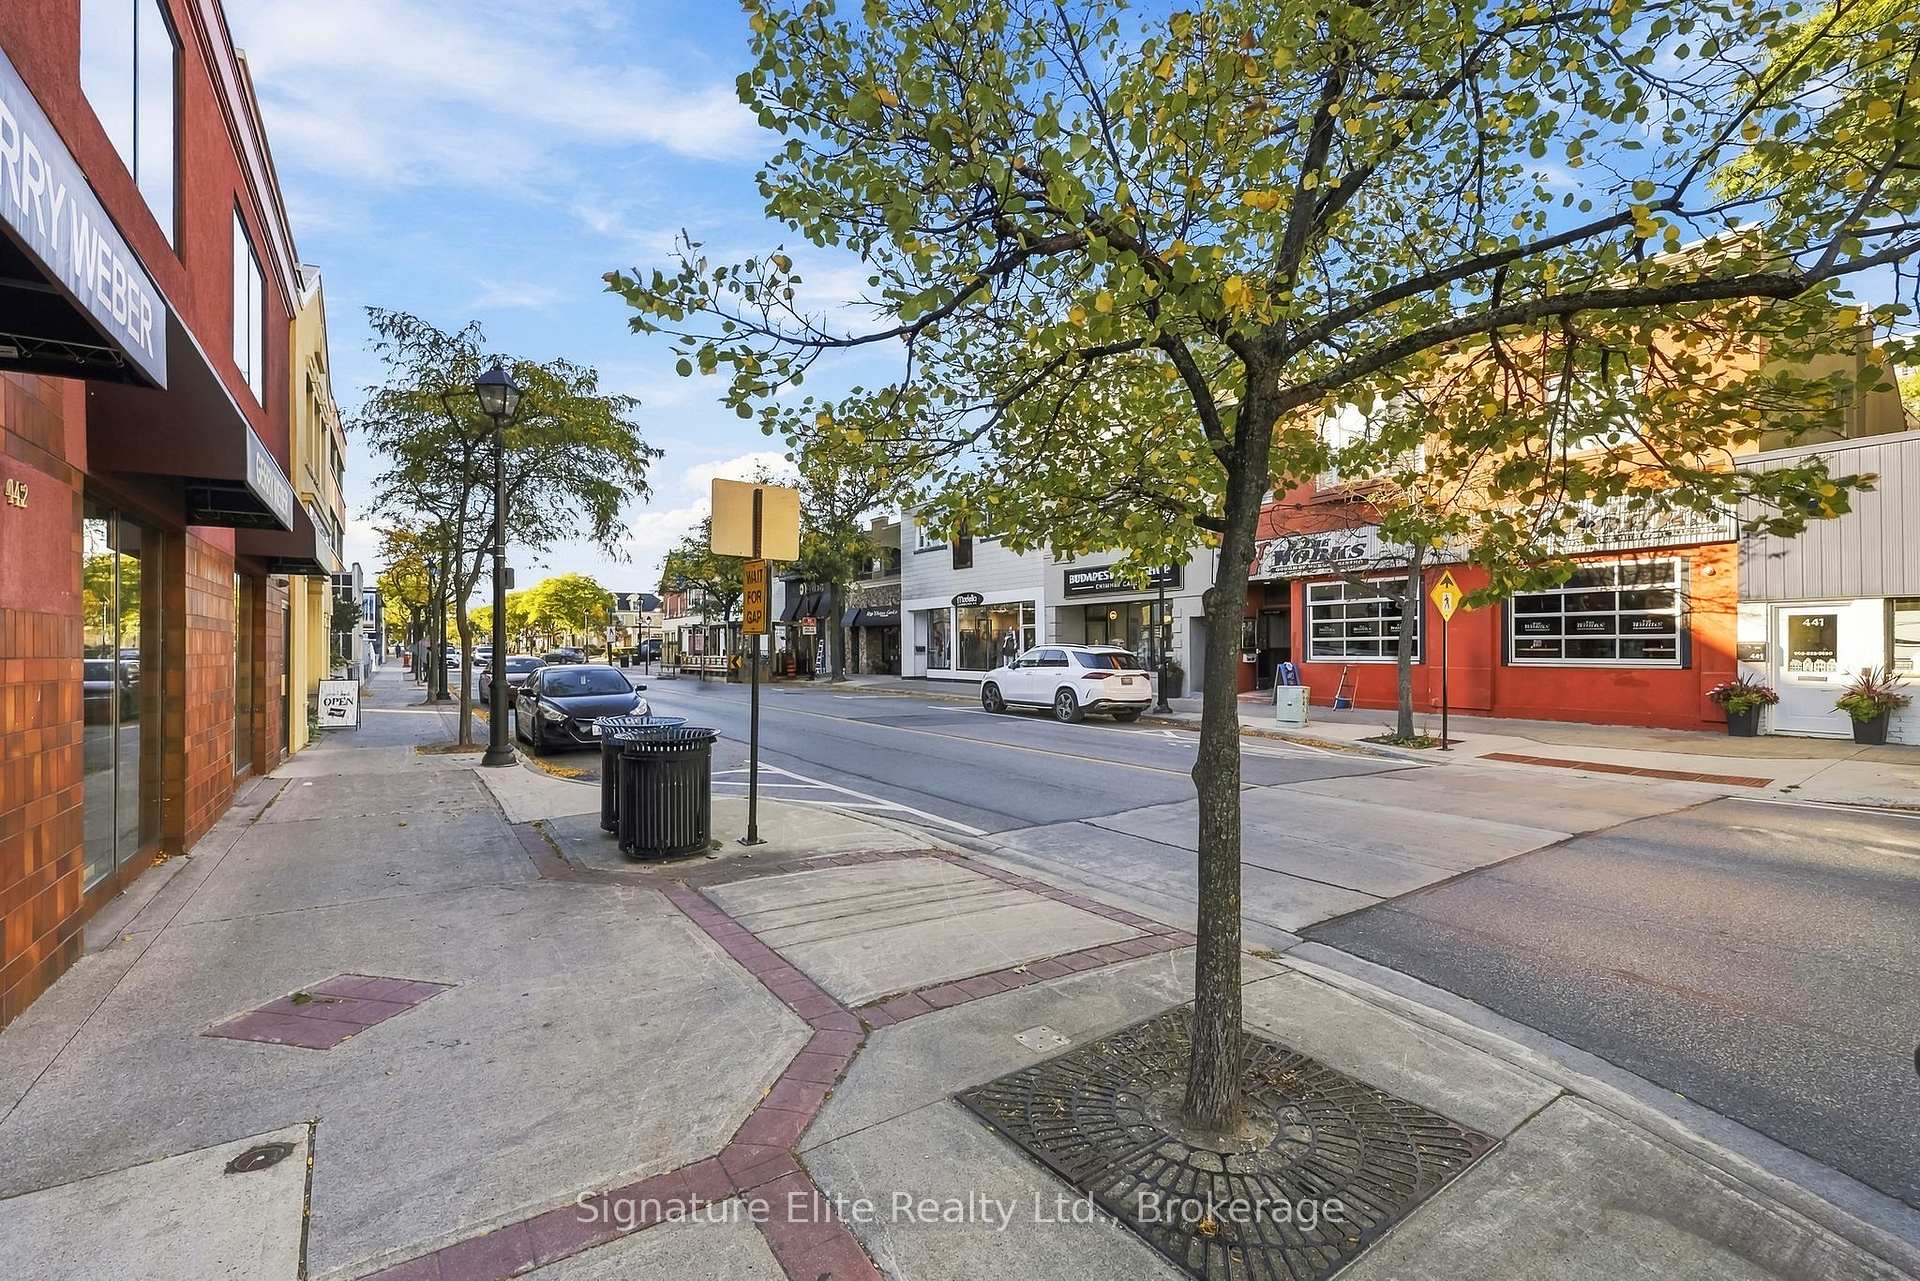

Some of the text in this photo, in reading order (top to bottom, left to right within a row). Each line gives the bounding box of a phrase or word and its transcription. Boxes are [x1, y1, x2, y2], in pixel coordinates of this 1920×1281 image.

[70, 198, 154, 360] WEBER
[5, 478, 28, 507] 442
[1273, 543, 1367, 566] WORKS
[746, 568, 763, 585] WAIT
[747, 590, 762, 604] FOR
[746, 610, 762, 625] GAP
[1802, 618, 1824, 627] 441
[323, 697, 354, 706] OPEN
